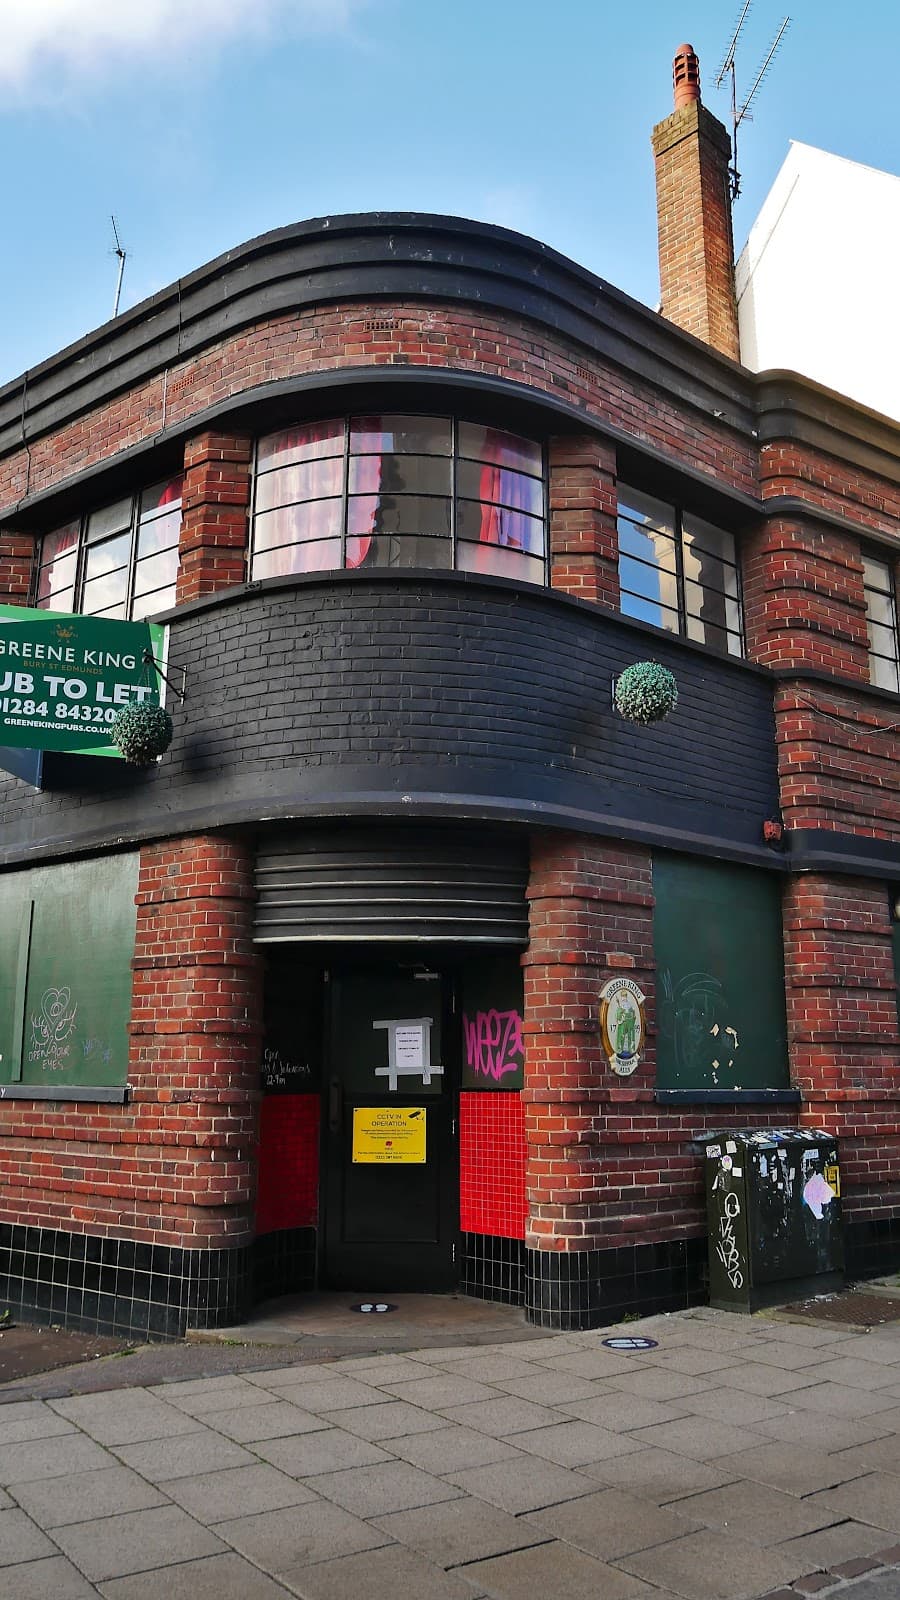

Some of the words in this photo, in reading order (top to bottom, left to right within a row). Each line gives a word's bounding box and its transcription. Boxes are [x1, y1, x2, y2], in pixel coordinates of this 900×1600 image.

[23, 660, 45, 669] BURY
[62, 665, 103, 675] EDMUNDS
[84, 650, 136, 669] KING
[43, 675, 87, 699] TO
[96, 682, 152, 705] LET
[0, 698, 48, 717] 1284
[4, 717, 112, 734] GREENEKINGPUBS.CO.UK
[628, 981, 641, 998] KING
